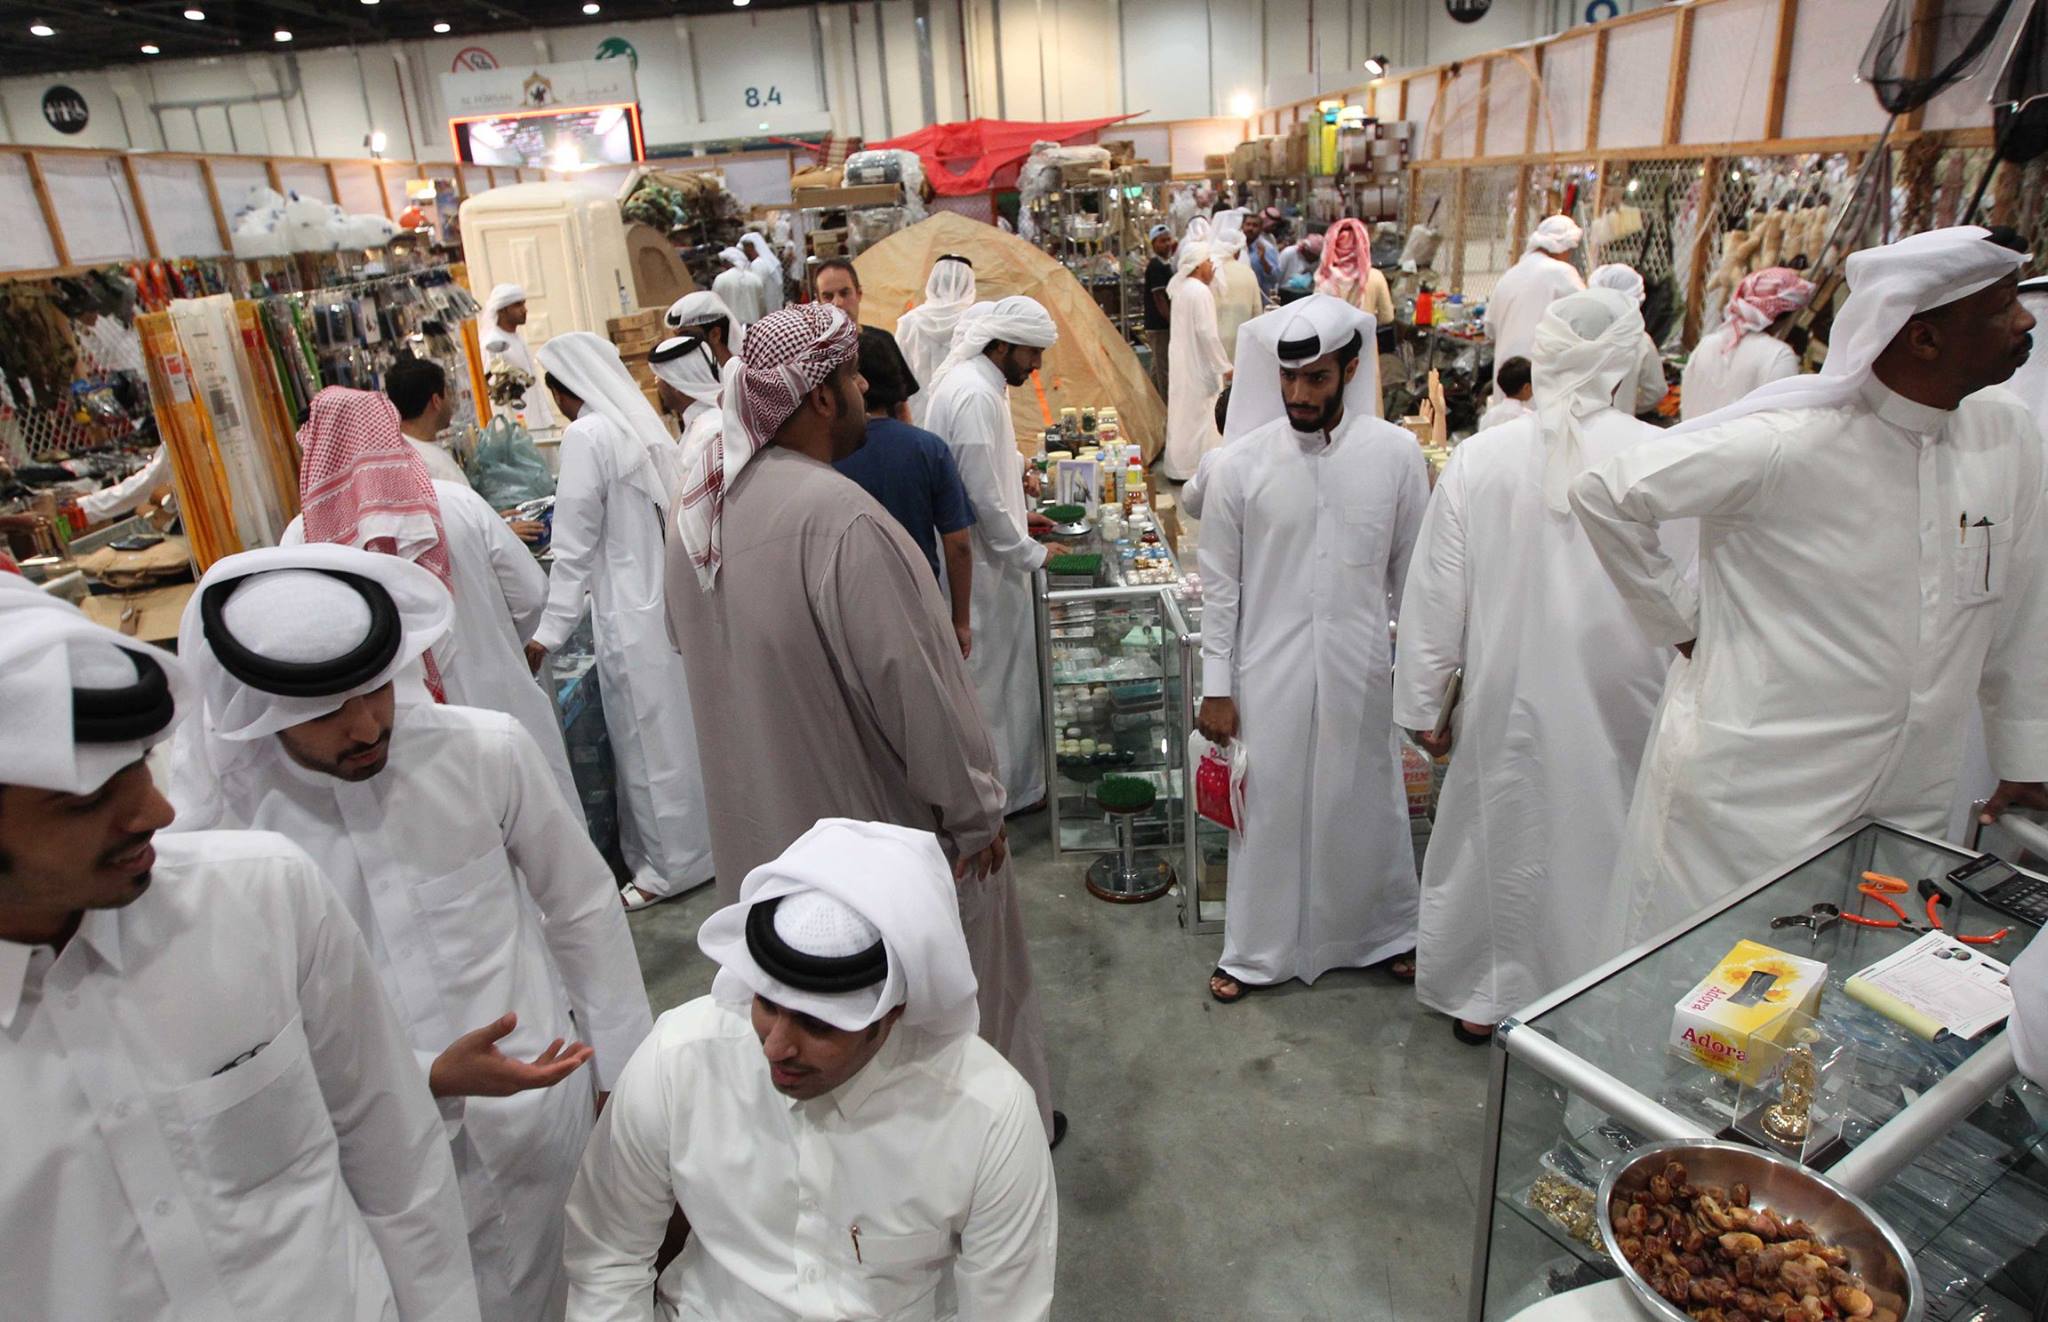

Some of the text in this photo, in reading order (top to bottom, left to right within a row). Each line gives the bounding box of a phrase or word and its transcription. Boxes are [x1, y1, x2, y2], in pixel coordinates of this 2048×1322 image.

[745, 86, 781, 108] 8.4
[1692, 986, 1727, 1011] Adora
[1681, 1027, 1747, 1061] Adora
